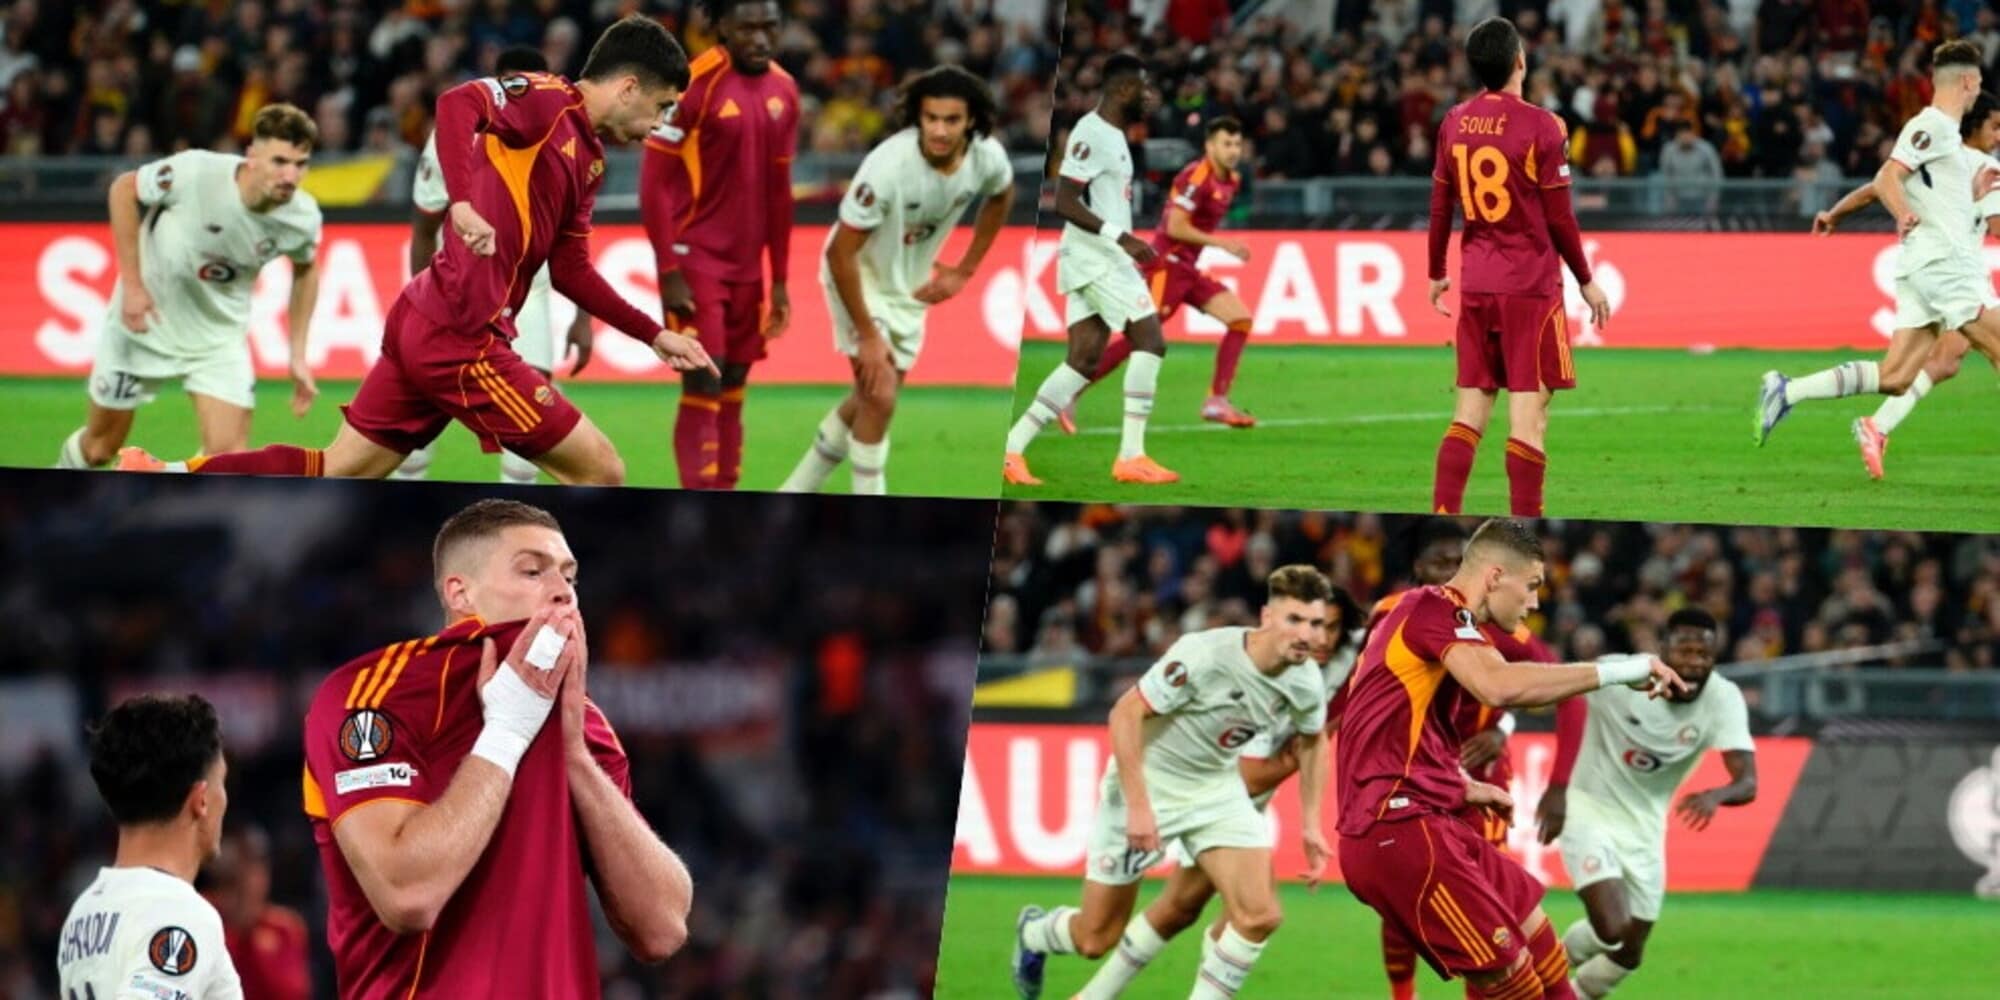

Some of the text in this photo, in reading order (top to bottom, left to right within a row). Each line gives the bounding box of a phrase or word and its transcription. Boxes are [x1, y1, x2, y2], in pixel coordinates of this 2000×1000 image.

[1459, 113, 1507, 136] SOULÉ
[1452, 143, 1511, 222] 18
[114, 370, 137, 398] 12
